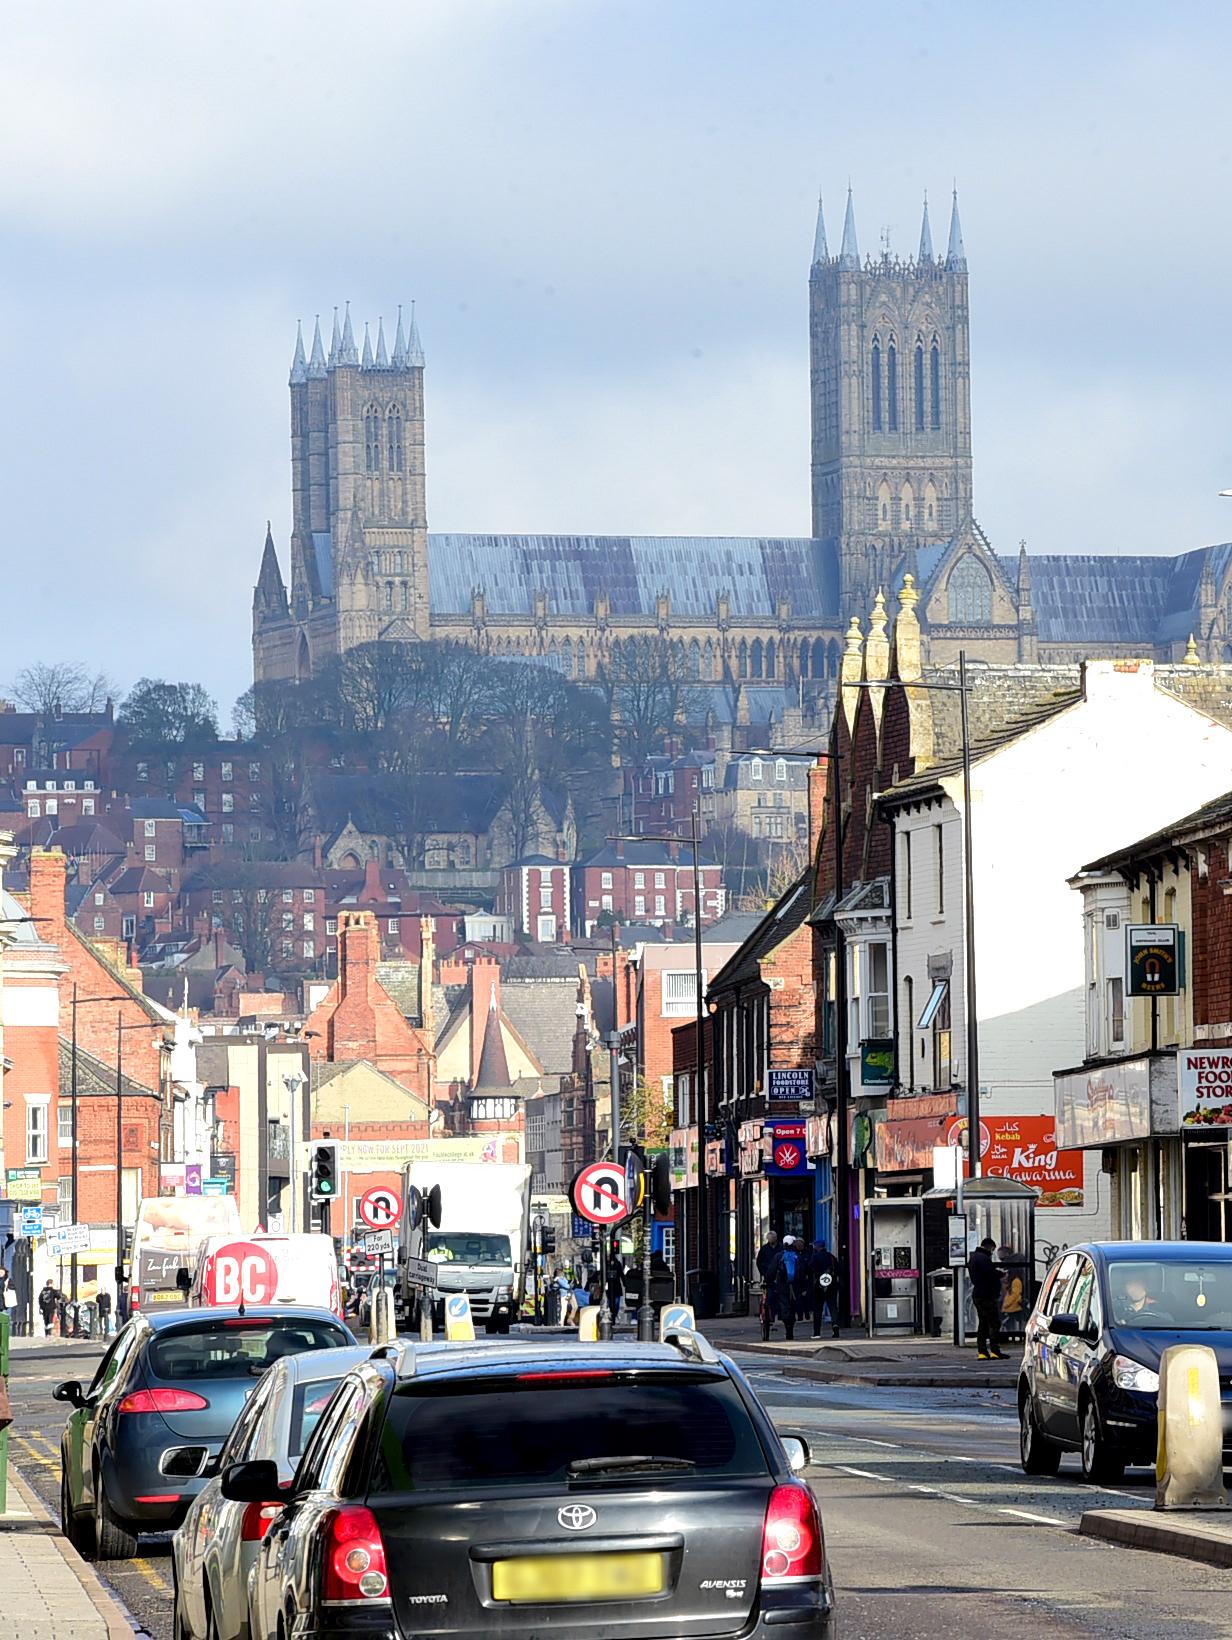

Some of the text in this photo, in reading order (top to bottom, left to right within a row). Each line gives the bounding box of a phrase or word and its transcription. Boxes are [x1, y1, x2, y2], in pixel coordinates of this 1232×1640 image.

[772, 1072, 809, 1080] LINCOLN
[775, 1127, 795, 1136] Open
[995, 1133, 1021, 1141] Kebab
[1011, 1147, 1058, 1169] King
[380, 1242, 391, 1251] yds
[216, 1255, 266, 1303] BC
[699, 1579, 747, 1589] AVENSIS
[409, 1593, 448, 1604] TOYOTA
